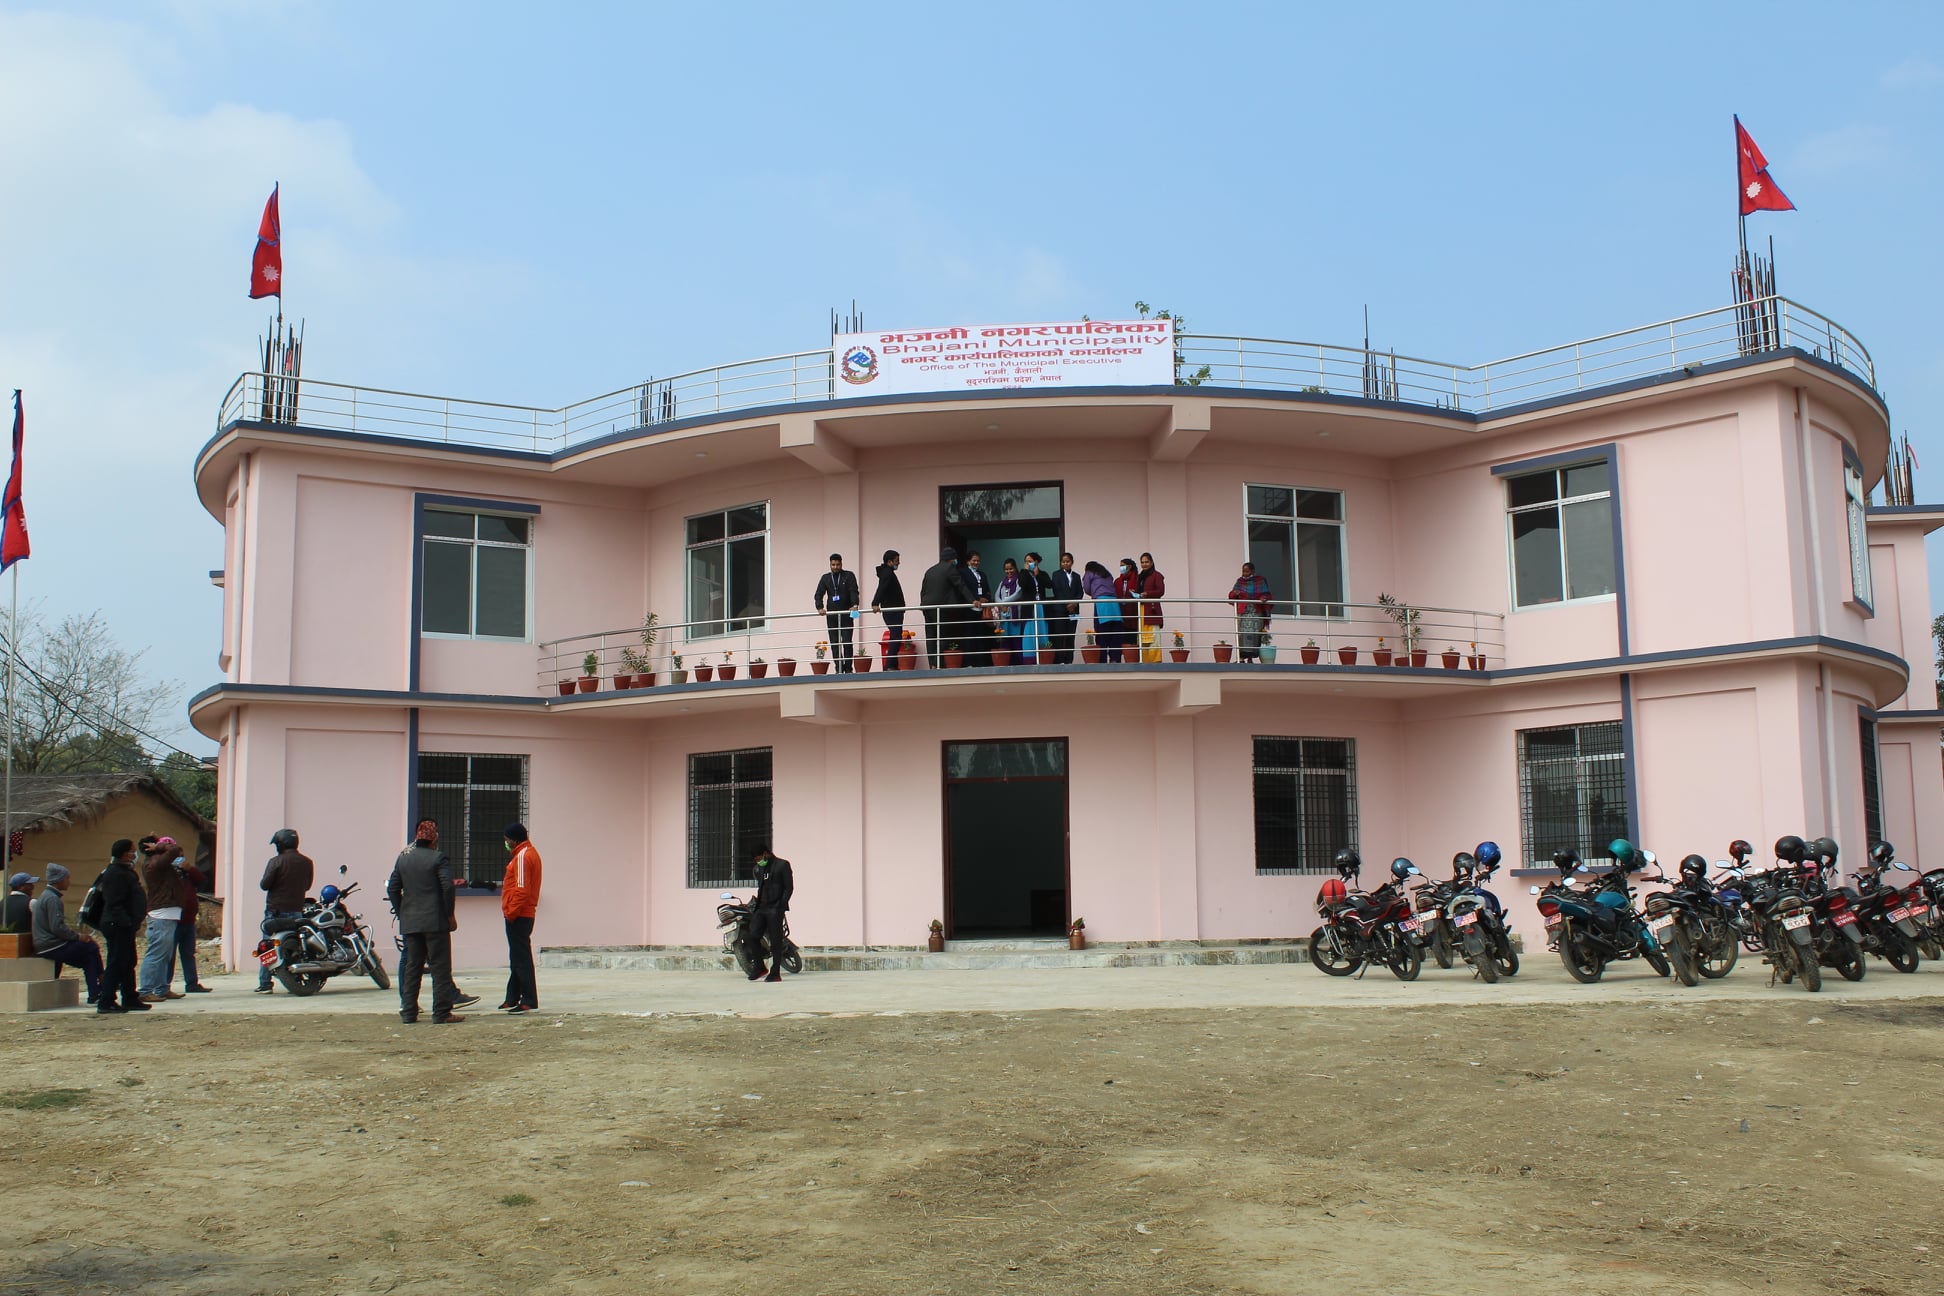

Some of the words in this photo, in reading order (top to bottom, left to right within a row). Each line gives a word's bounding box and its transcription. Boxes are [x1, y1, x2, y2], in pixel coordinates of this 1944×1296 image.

[880, 327, 970, 344] भजनी
[980, 321, 1168, 338] नगरपालिका
[882, 340, 986, 354] Bhajani
[999, 334, 1168, 348] Municipality
[900, 355, 940, 365] नगर
[944, 348, 1065, 362] कार्यपालिकाको
[1069, 346, 1143, 356] कार्यालय
[919, 364, 954, 372] Office
[974, 361, 996, 369] The
[1000, 358, 1058, 367] Municipal
[1063, 357, 1122, 365] Executive
